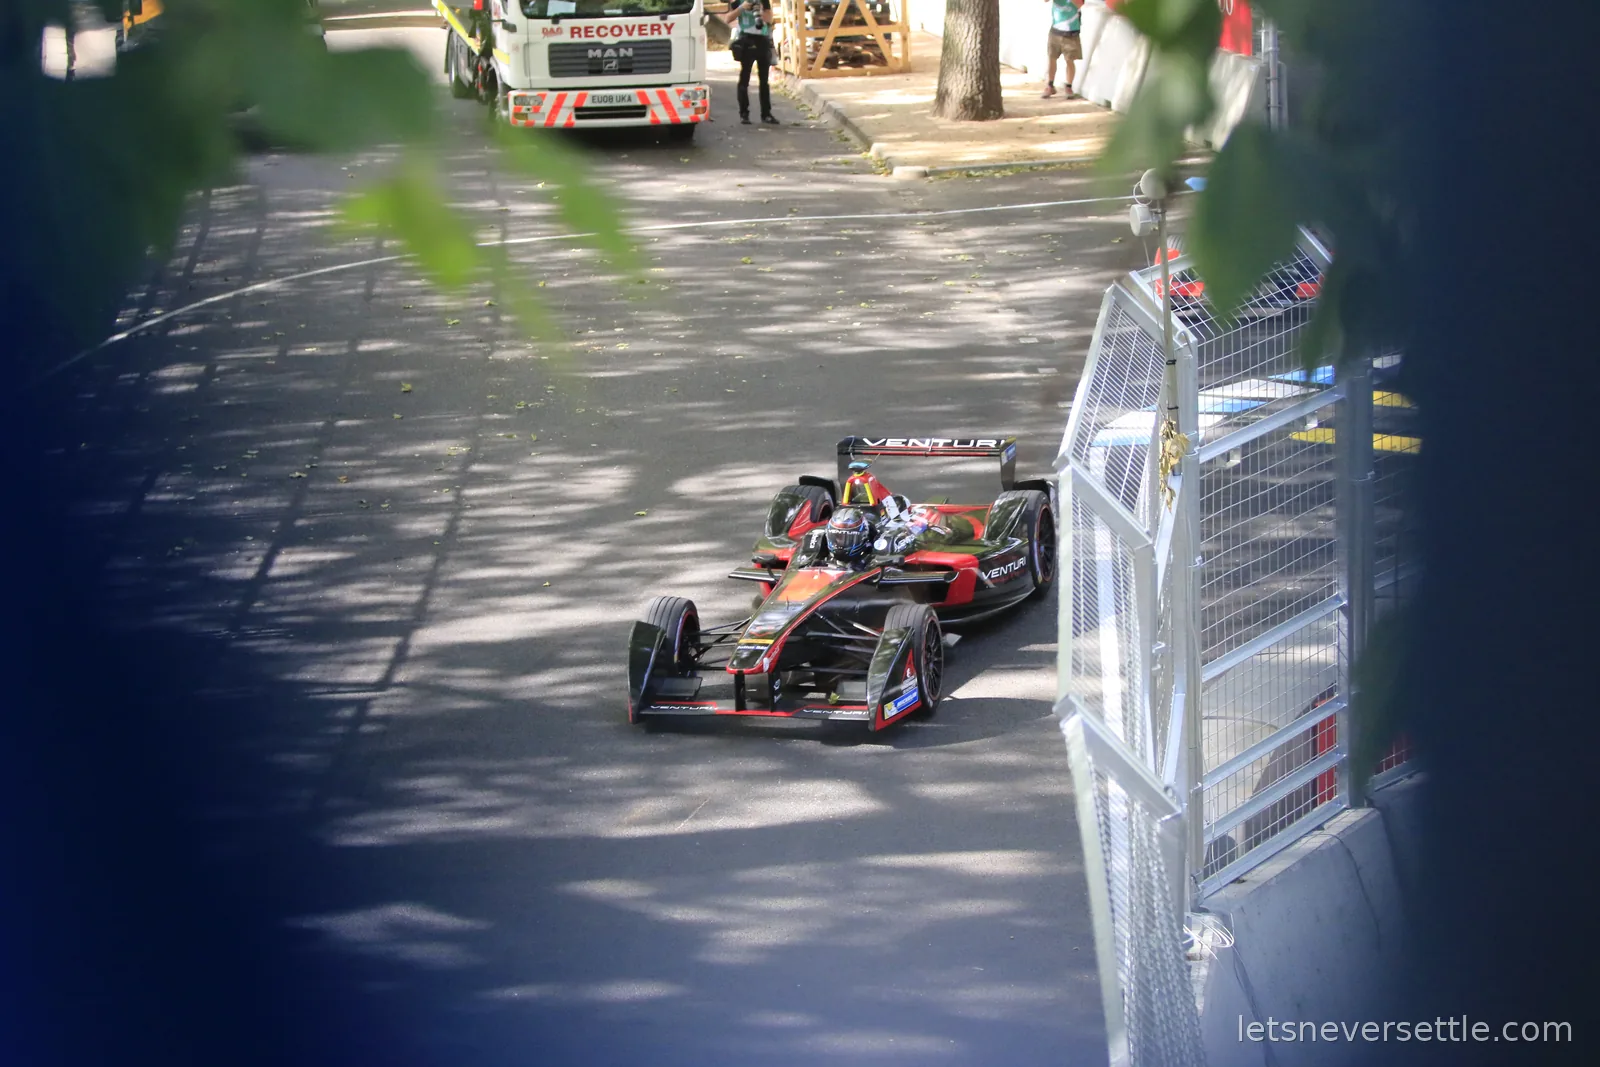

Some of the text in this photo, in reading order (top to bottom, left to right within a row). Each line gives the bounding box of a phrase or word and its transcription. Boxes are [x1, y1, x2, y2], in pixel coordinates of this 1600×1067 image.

[570, 23, 675, 39] RECOVERY
[587, 48, 633, 58] MAN
[591, 93, 633, 104] EU08 UKA
[981, 556, 1027, 580] VENTURI
